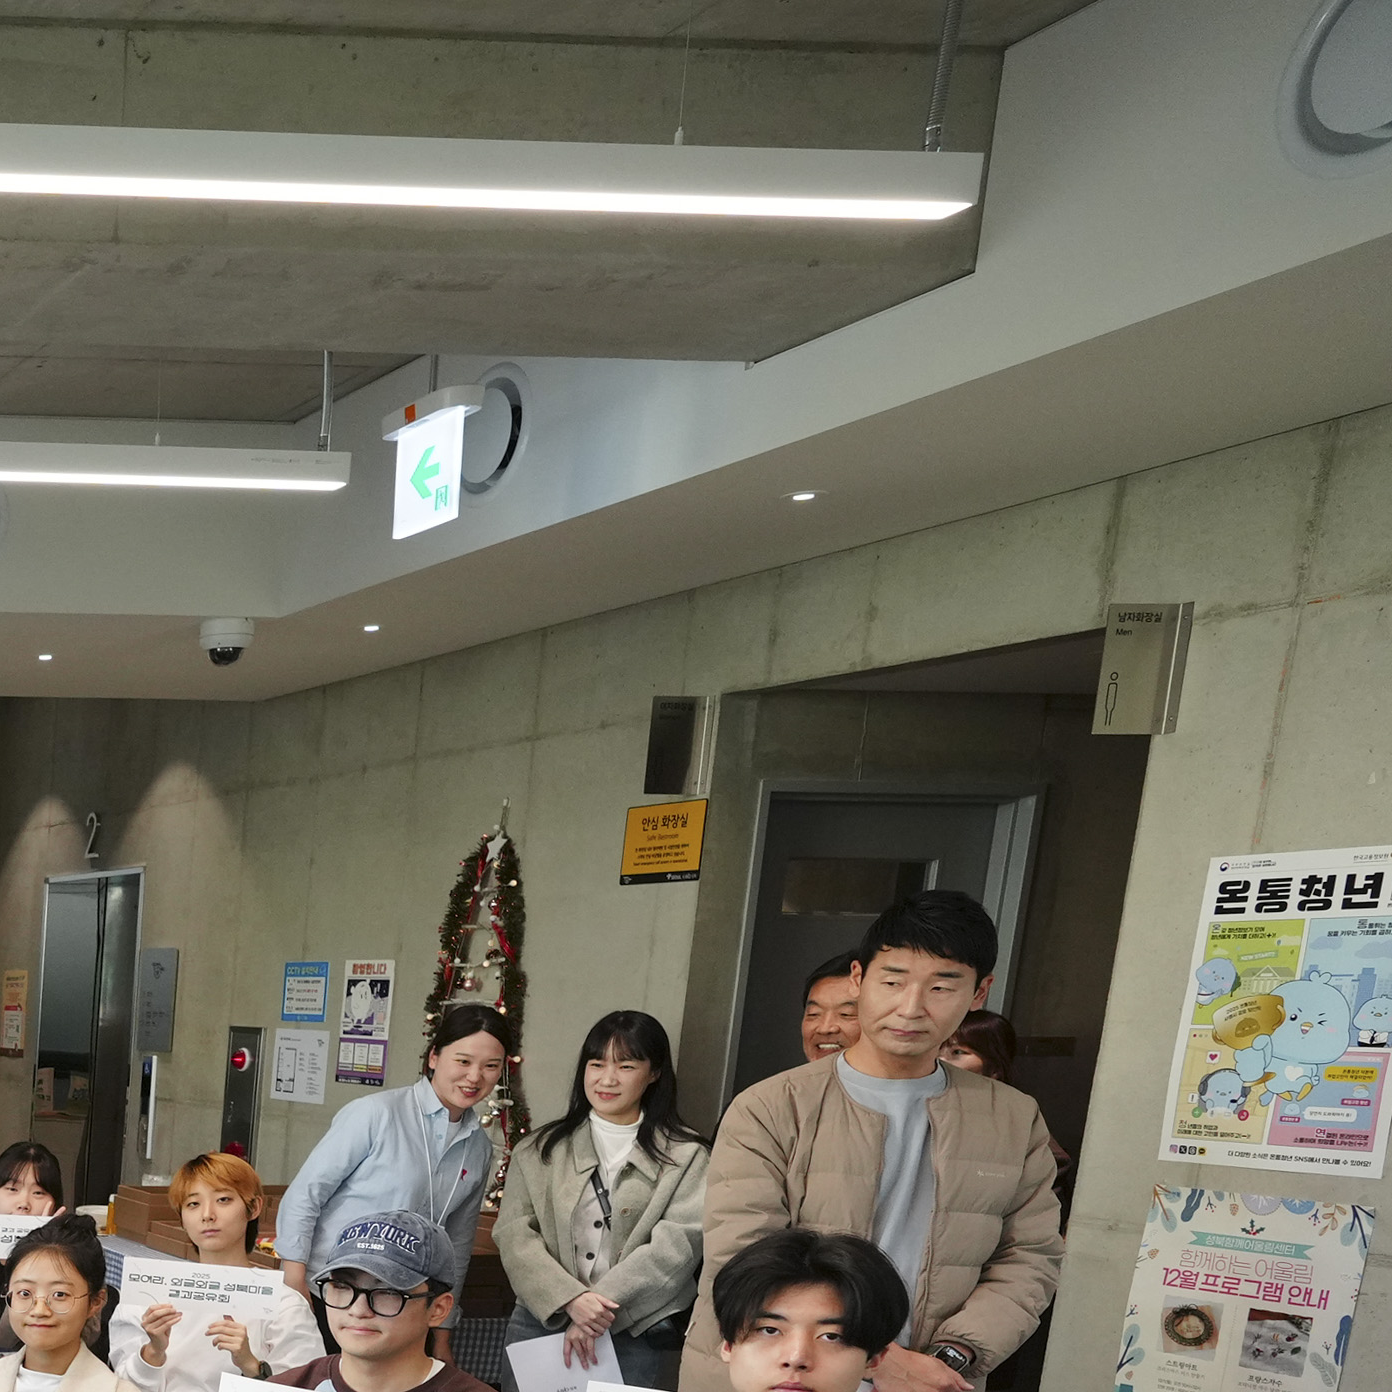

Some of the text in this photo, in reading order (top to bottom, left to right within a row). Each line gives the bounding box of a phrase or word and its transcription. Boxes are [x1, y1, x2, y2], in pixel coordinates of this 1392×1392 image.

[1118, 612, 1163, 623] 남자화장실
[1116, 628, 1133, 636] Men
[642, 813, 689, 832] 안심 화장실
[1214, 871, 1385, 916] 온통청년
[1205, 1235, 1296, 1256] 성북함께어울림센터
[1179, 1249, 1314, 1284] 함께하는 어울림
[129, 1273, 274, 1296] 모여라. 와글와글 성북마을
[192, 1272, 211, 1280] 2025
[168, 1289, 231, 1304] 결과공유회
[1162, 1267, 1331, 1311] 12월 프로그램 안내
[1166, 1359, 1199, 1372] 스트링아트
[1248, 1374, 1283, 1387] 프랑스자수
